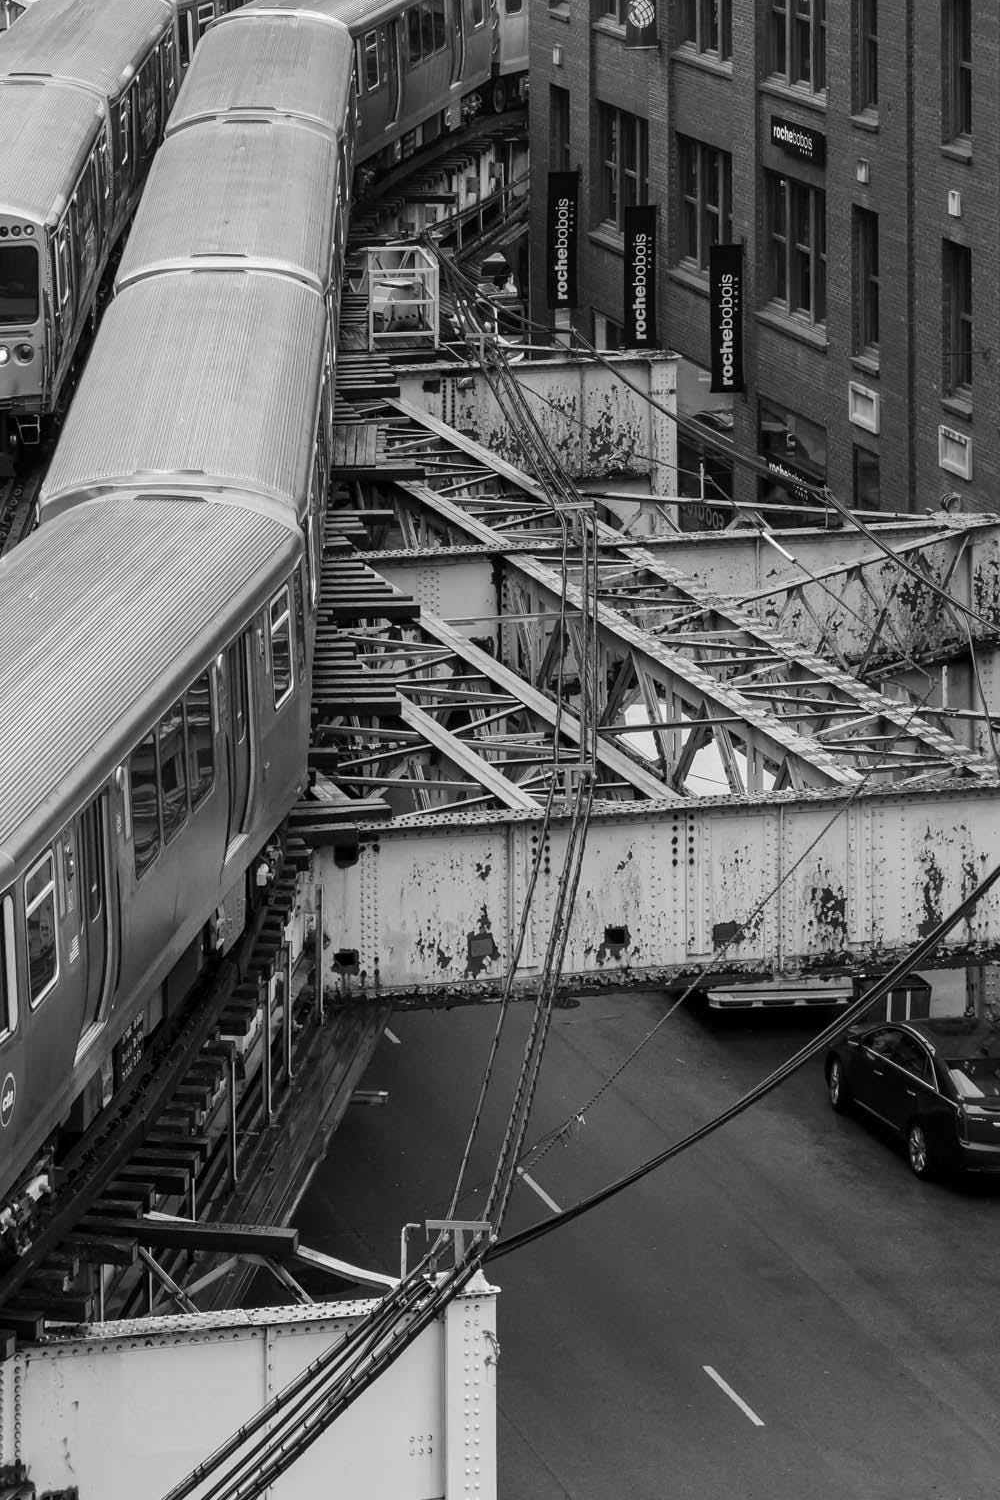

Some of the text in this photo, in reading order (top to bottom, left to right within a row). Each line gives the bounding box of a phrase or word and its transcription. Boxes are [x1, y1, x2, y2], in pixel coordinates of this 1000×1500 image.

[773, 125, 813, 150] rochebobois
[554, 198, 569, 300] rochebobois
[632, 233, 647, 340] rochebobois
[718, 273, 734, 386] rochebobois
